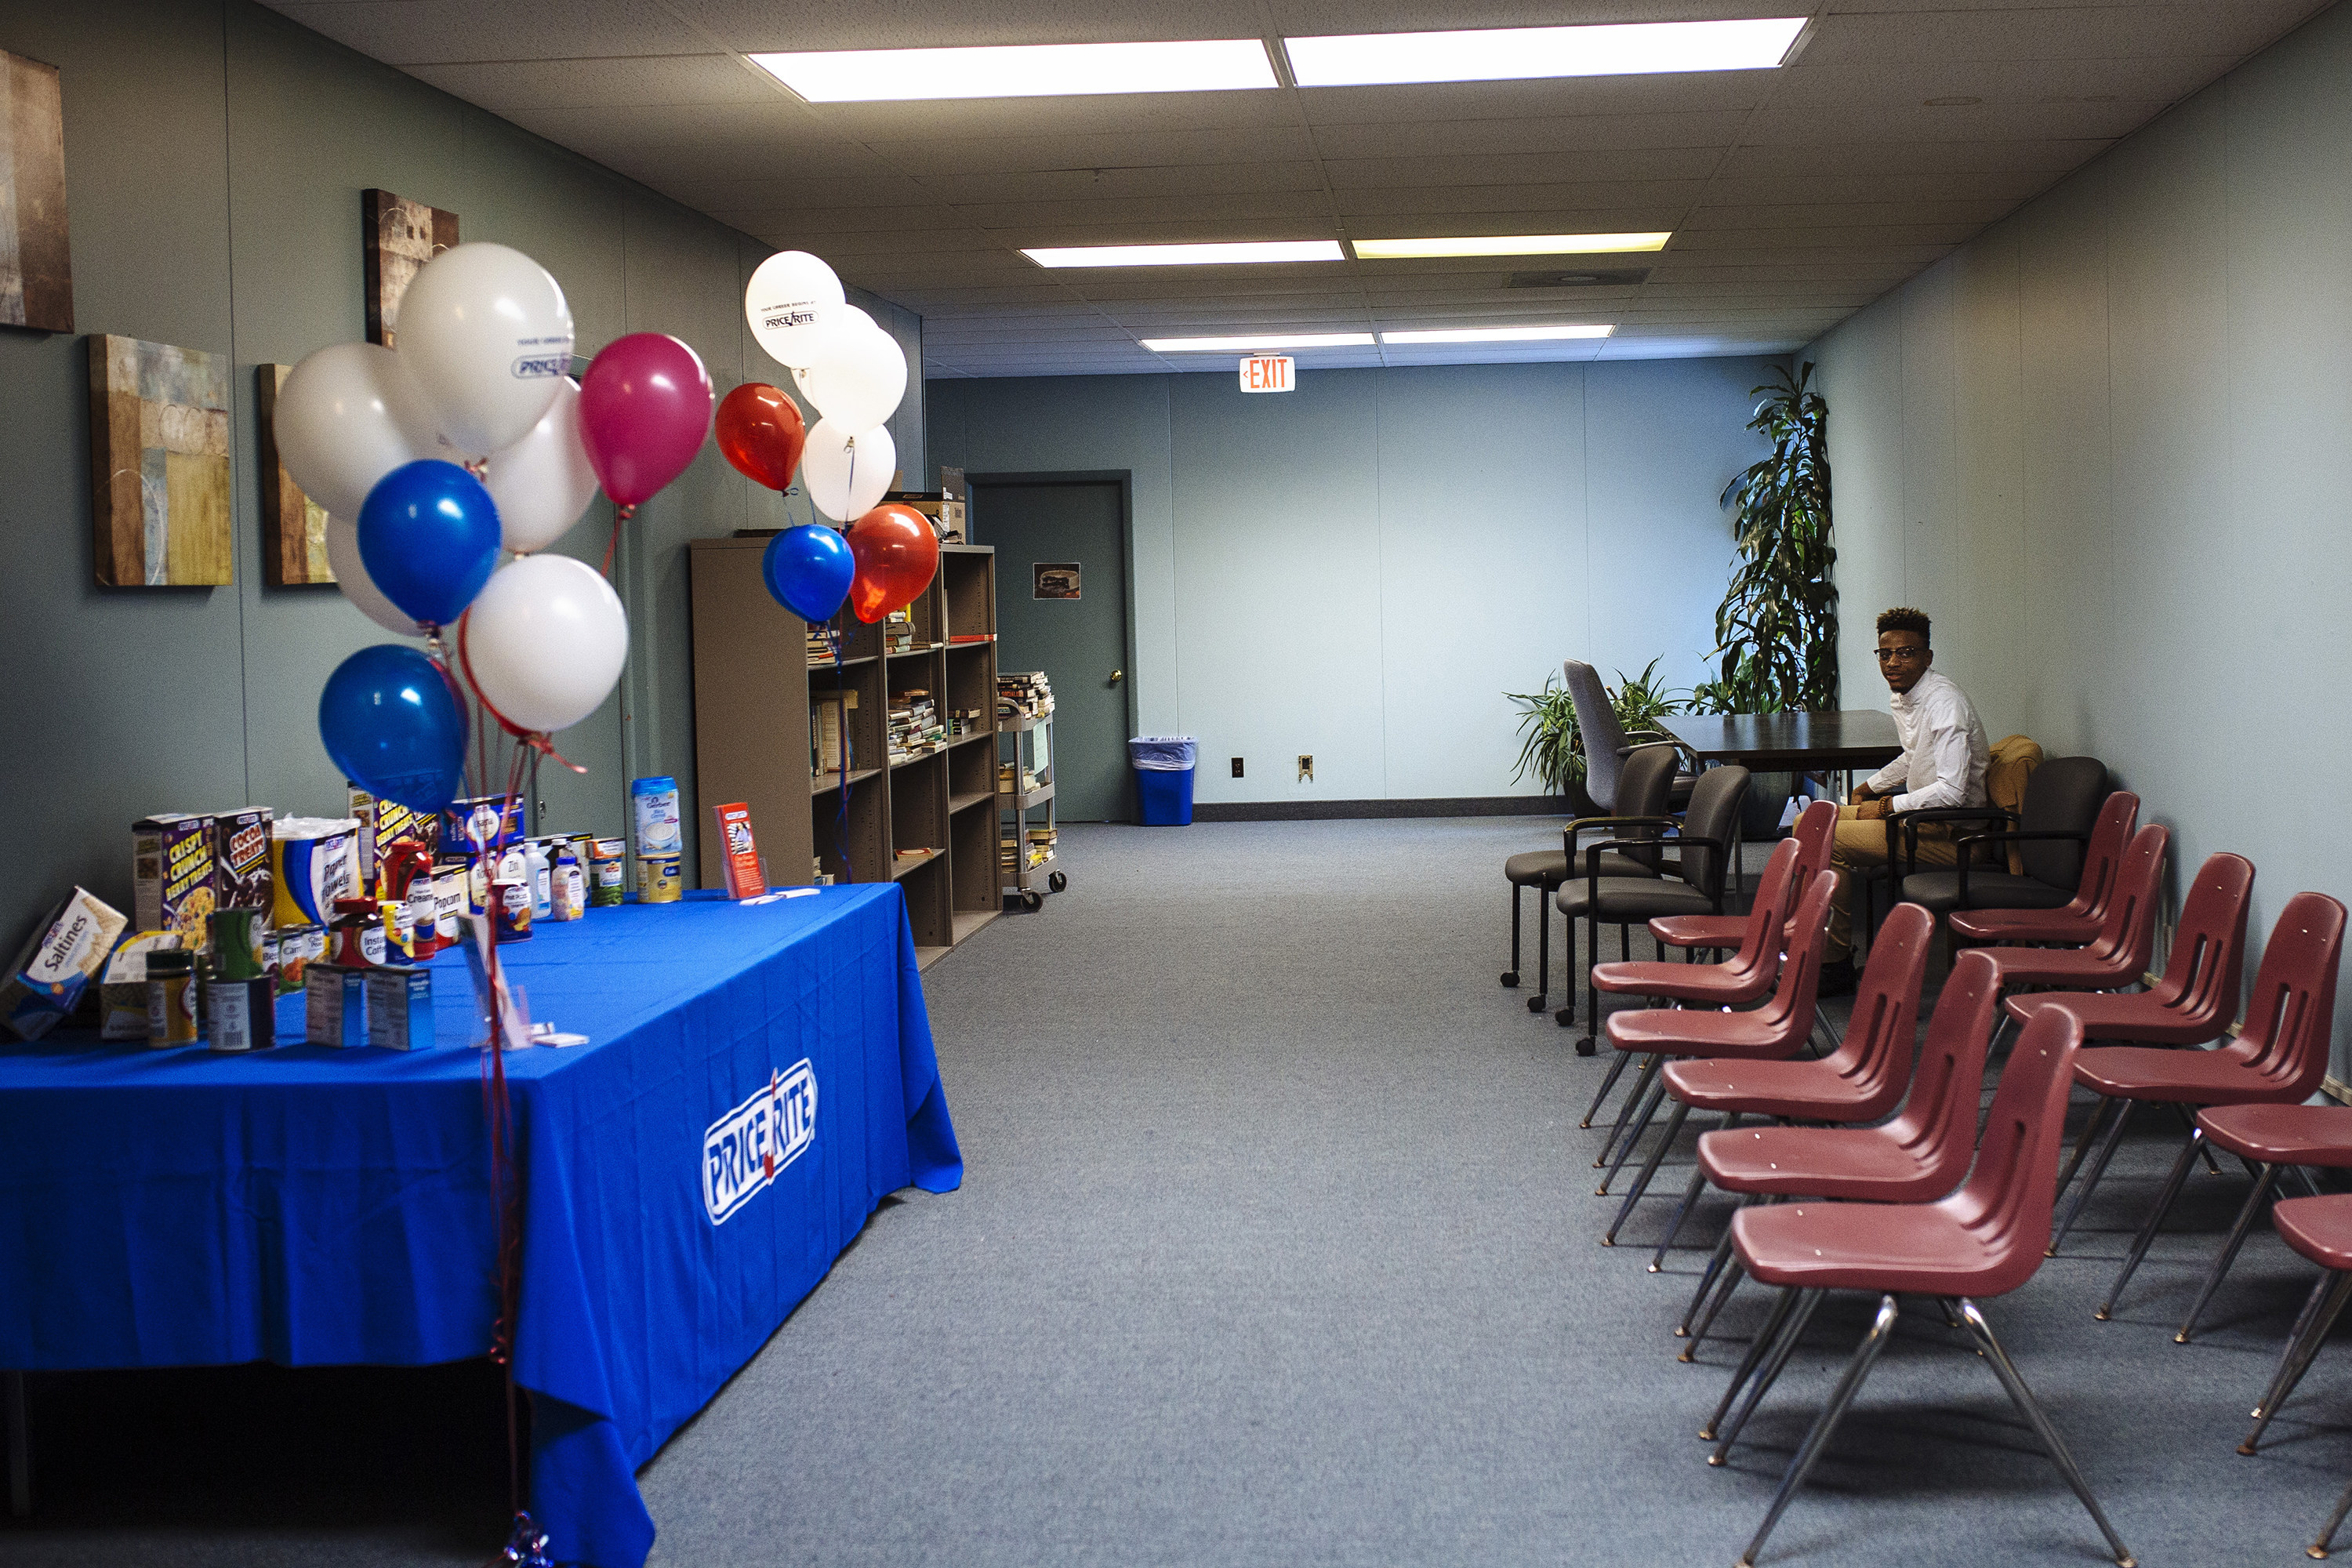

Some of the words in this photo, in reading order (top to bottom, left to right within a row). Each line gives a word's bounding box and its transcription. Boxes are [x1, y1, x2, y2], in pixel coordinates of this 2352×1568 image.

[765, 316, 790, 328] PRICE
[793, 313, 815, 324] RITE
[1250, 359, 1287, 388] EXIT
[169, 829, 203, 864] CRISPY
[231, 824, 263, 850] COCOA
[169, 844, 208, 882] CRUNCH
[231, 841, 265, 866] TREATS
[508, 860, 519, 873] Ziti
[165, 877, 190, 902] BERRY
[190, 859, 214, 886] TREATS
[324, 855, 347, 882] Paper
[322, 871, 350, 903] Towels
[408, 894, 434, 904] Creame
[434, 893, 461, 910] Popcorn
[44, 915, 88, 972] Saltines
[364, 937, 385, 946] Insta
[707, 1108, 768, 1206] PRICE
[772, 1075, 811, 1156] RITE
